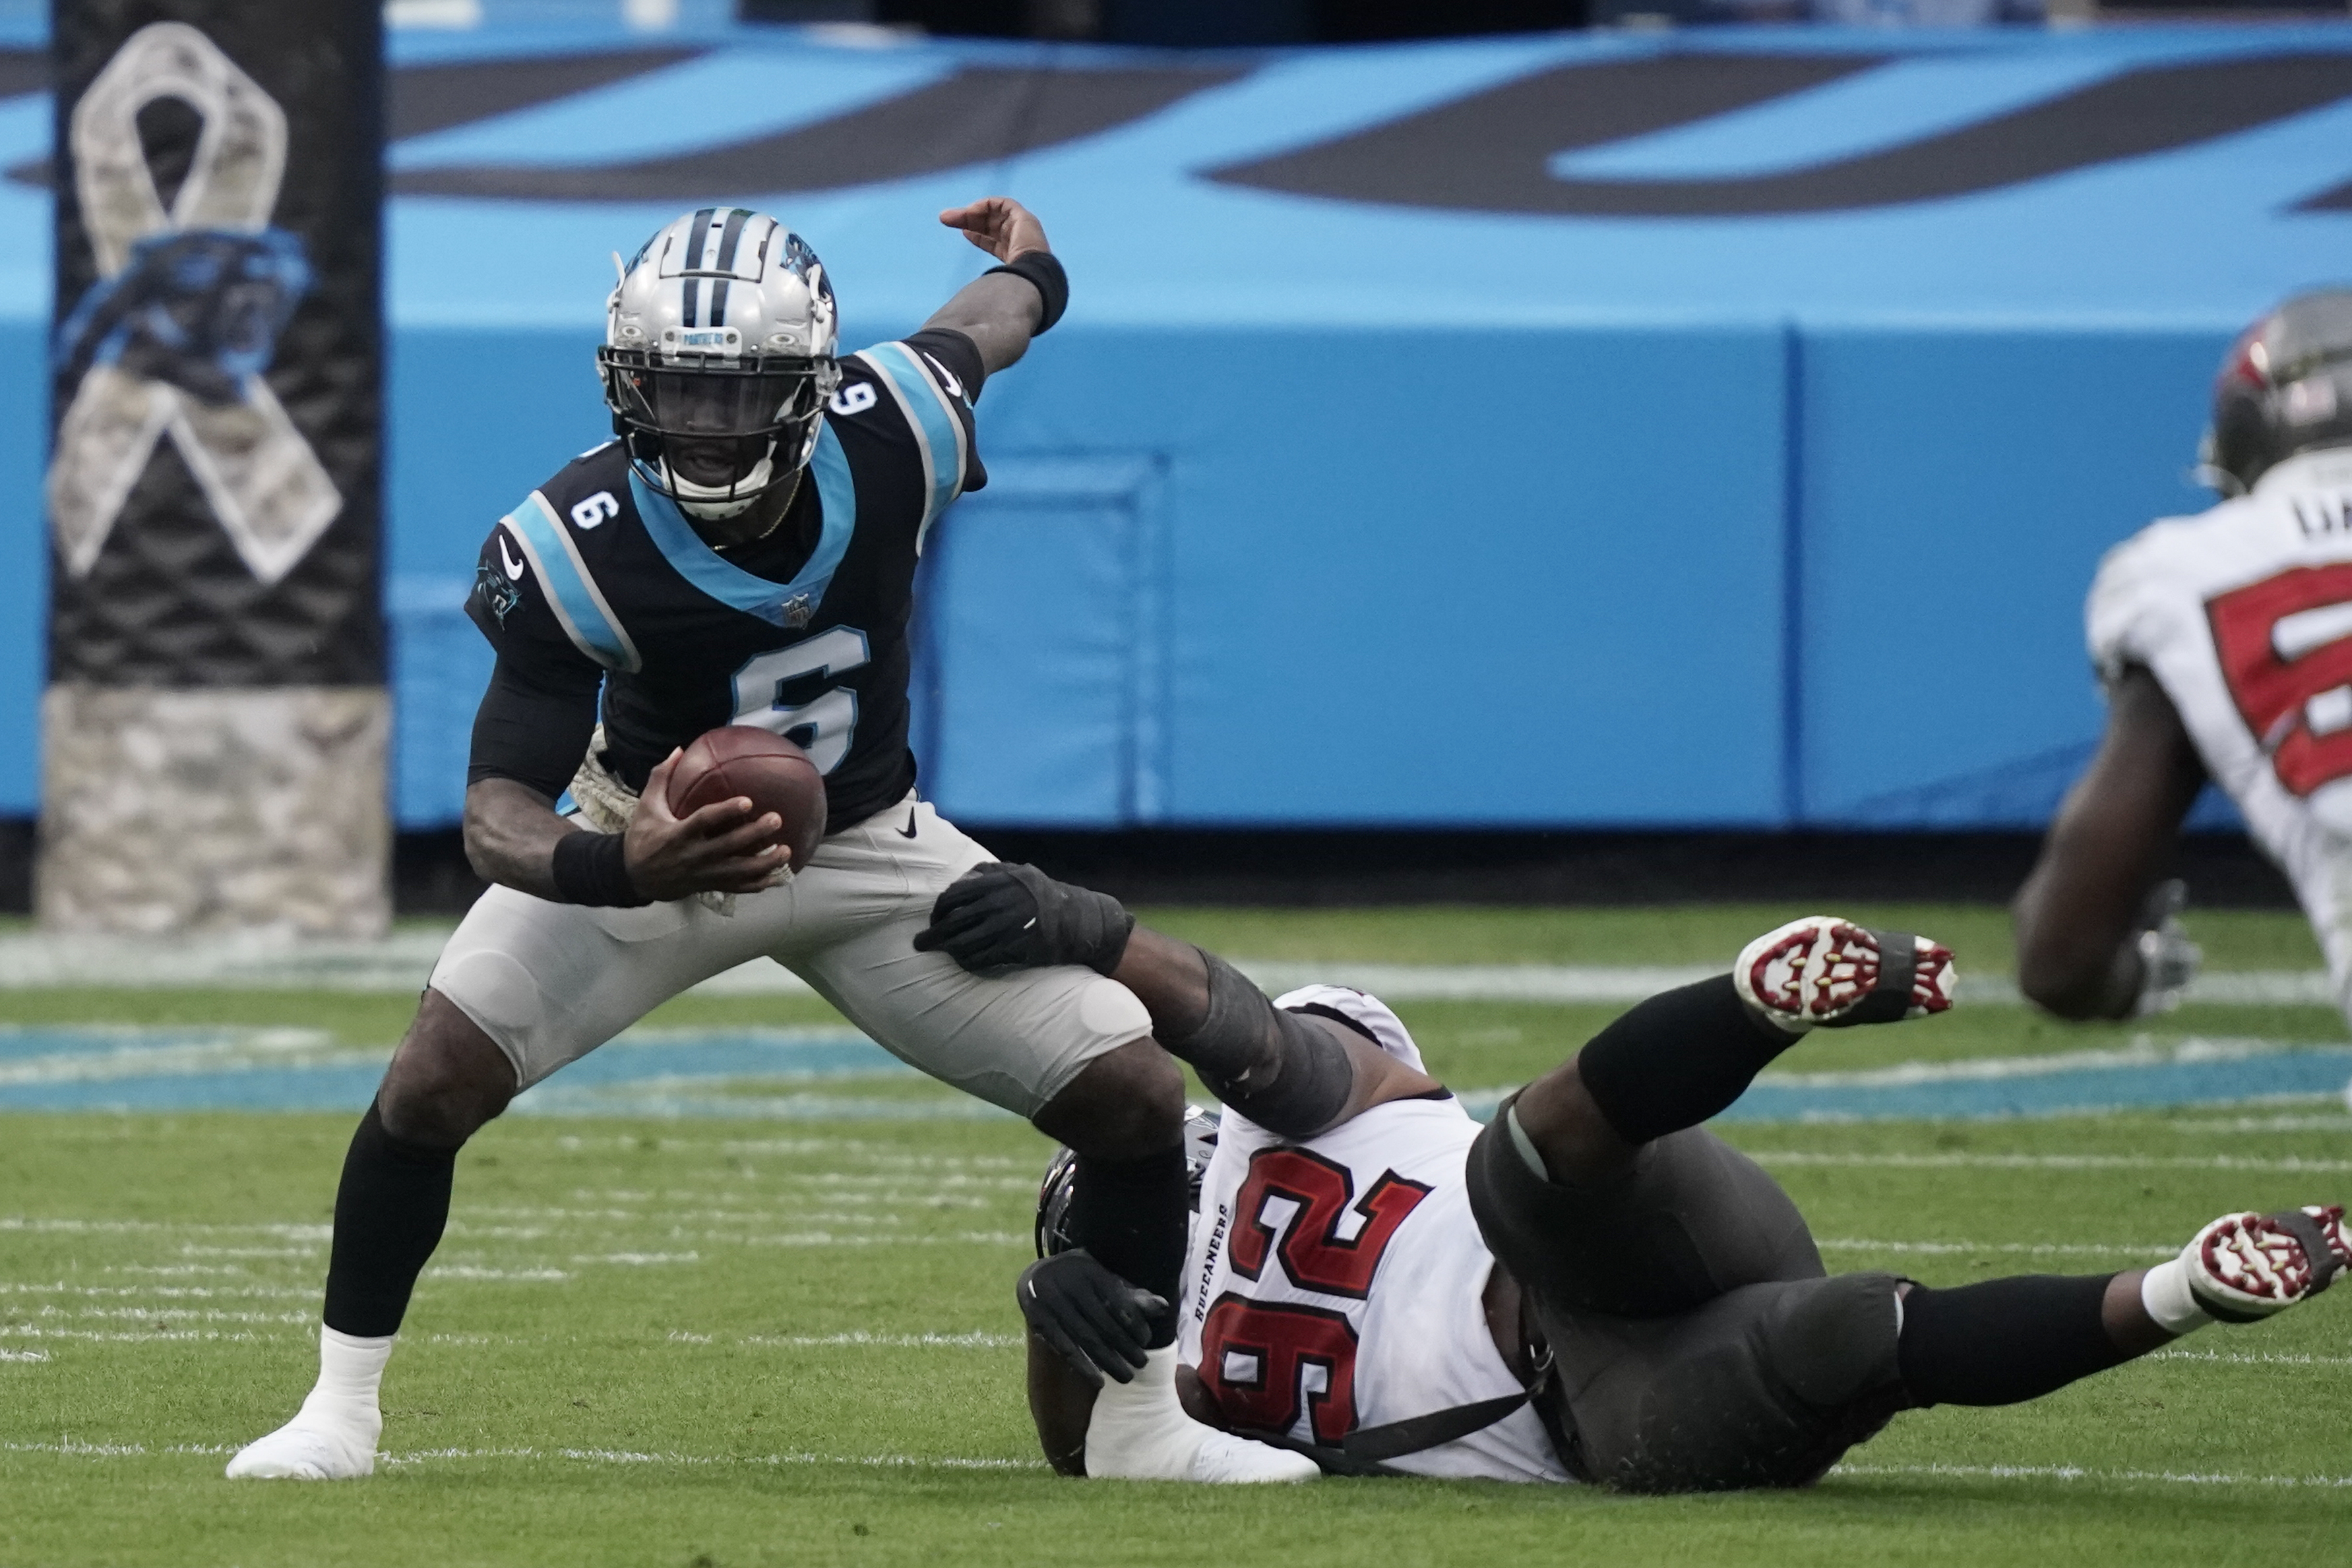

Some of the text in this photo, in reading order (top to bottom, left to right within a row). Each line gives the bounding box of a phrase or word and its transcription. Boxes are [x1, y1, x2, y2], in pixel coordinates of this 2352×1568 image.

[570, 491, 619, 529] 6
[728, 623, 871, 776] 6
[1194, 1203, 1227, 1323] BUCCANEERS
[1197, 1145, 1436, 1449] 92
